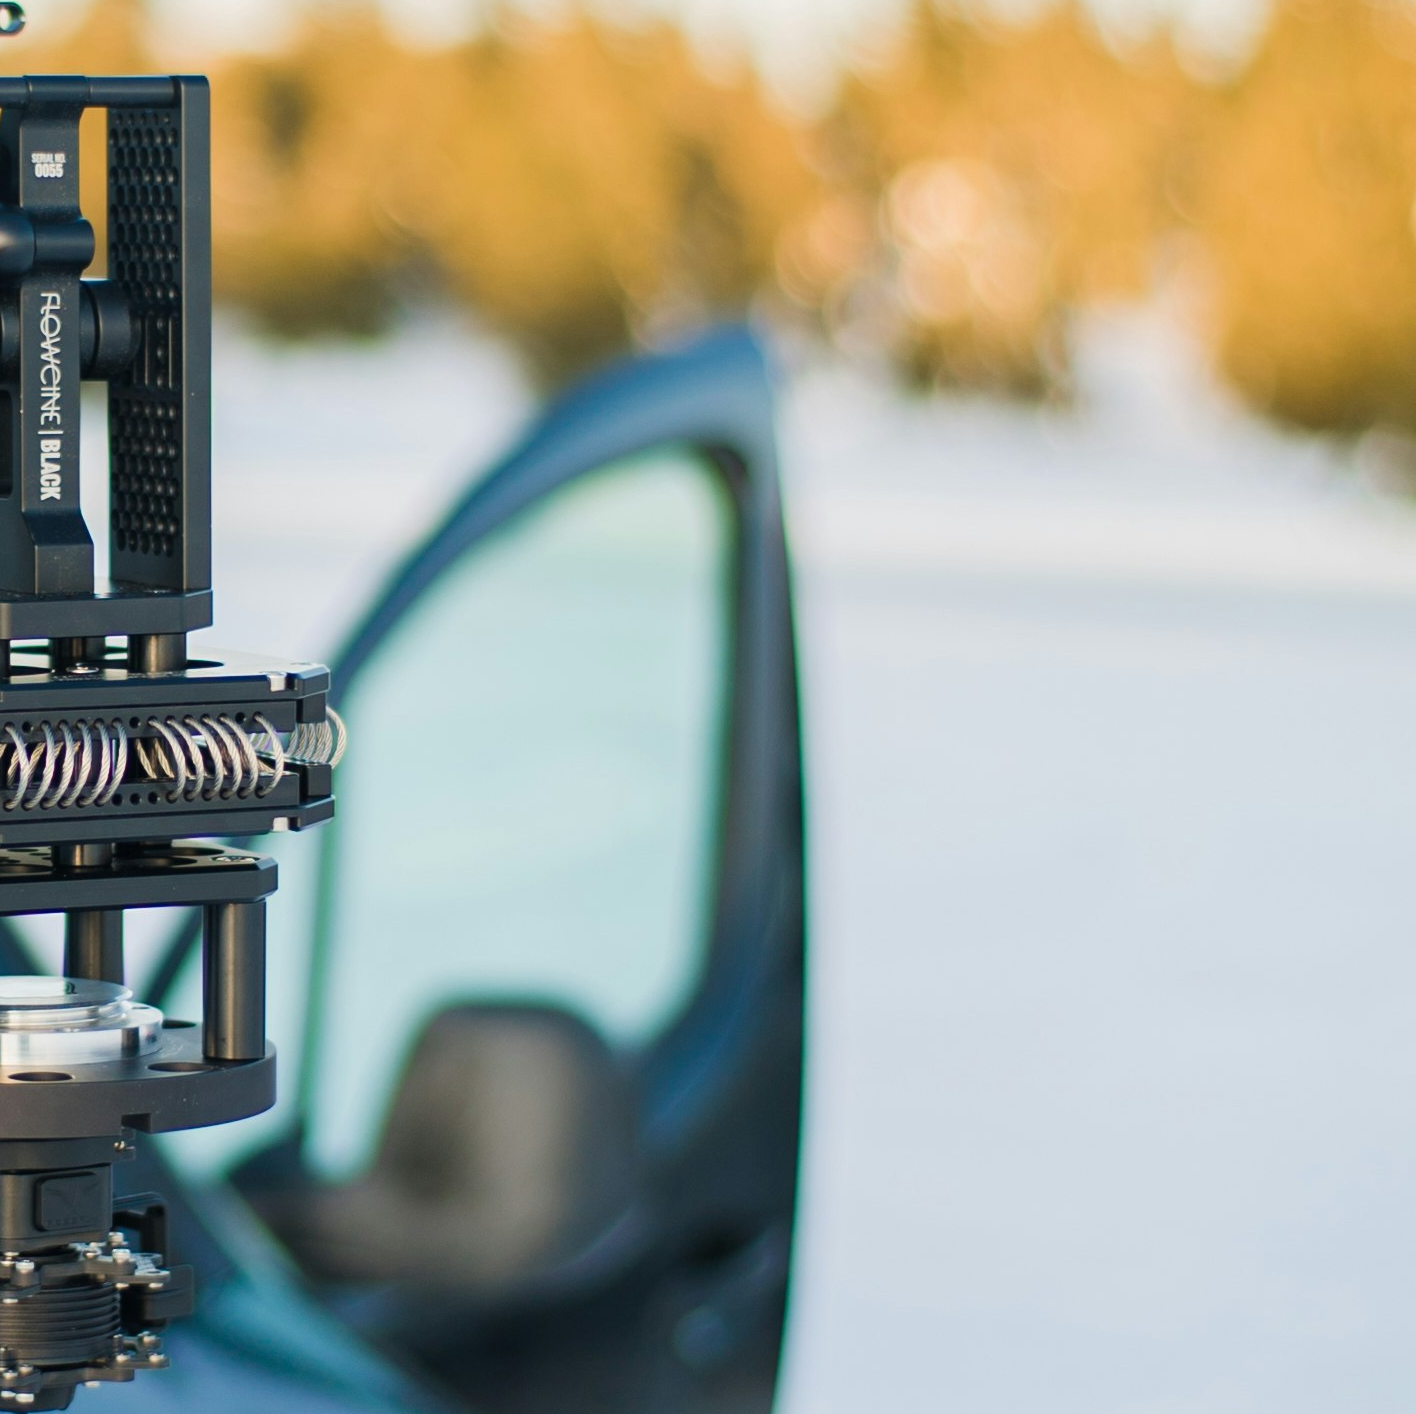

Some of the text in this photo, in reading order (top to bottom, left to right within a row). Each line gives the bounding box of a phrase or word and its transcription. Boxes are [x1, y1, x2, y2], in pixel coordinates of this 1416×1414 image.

[35, 163, 64, 178] 0055
[40, 292, 61, 501] FLOWCINE BLACK
